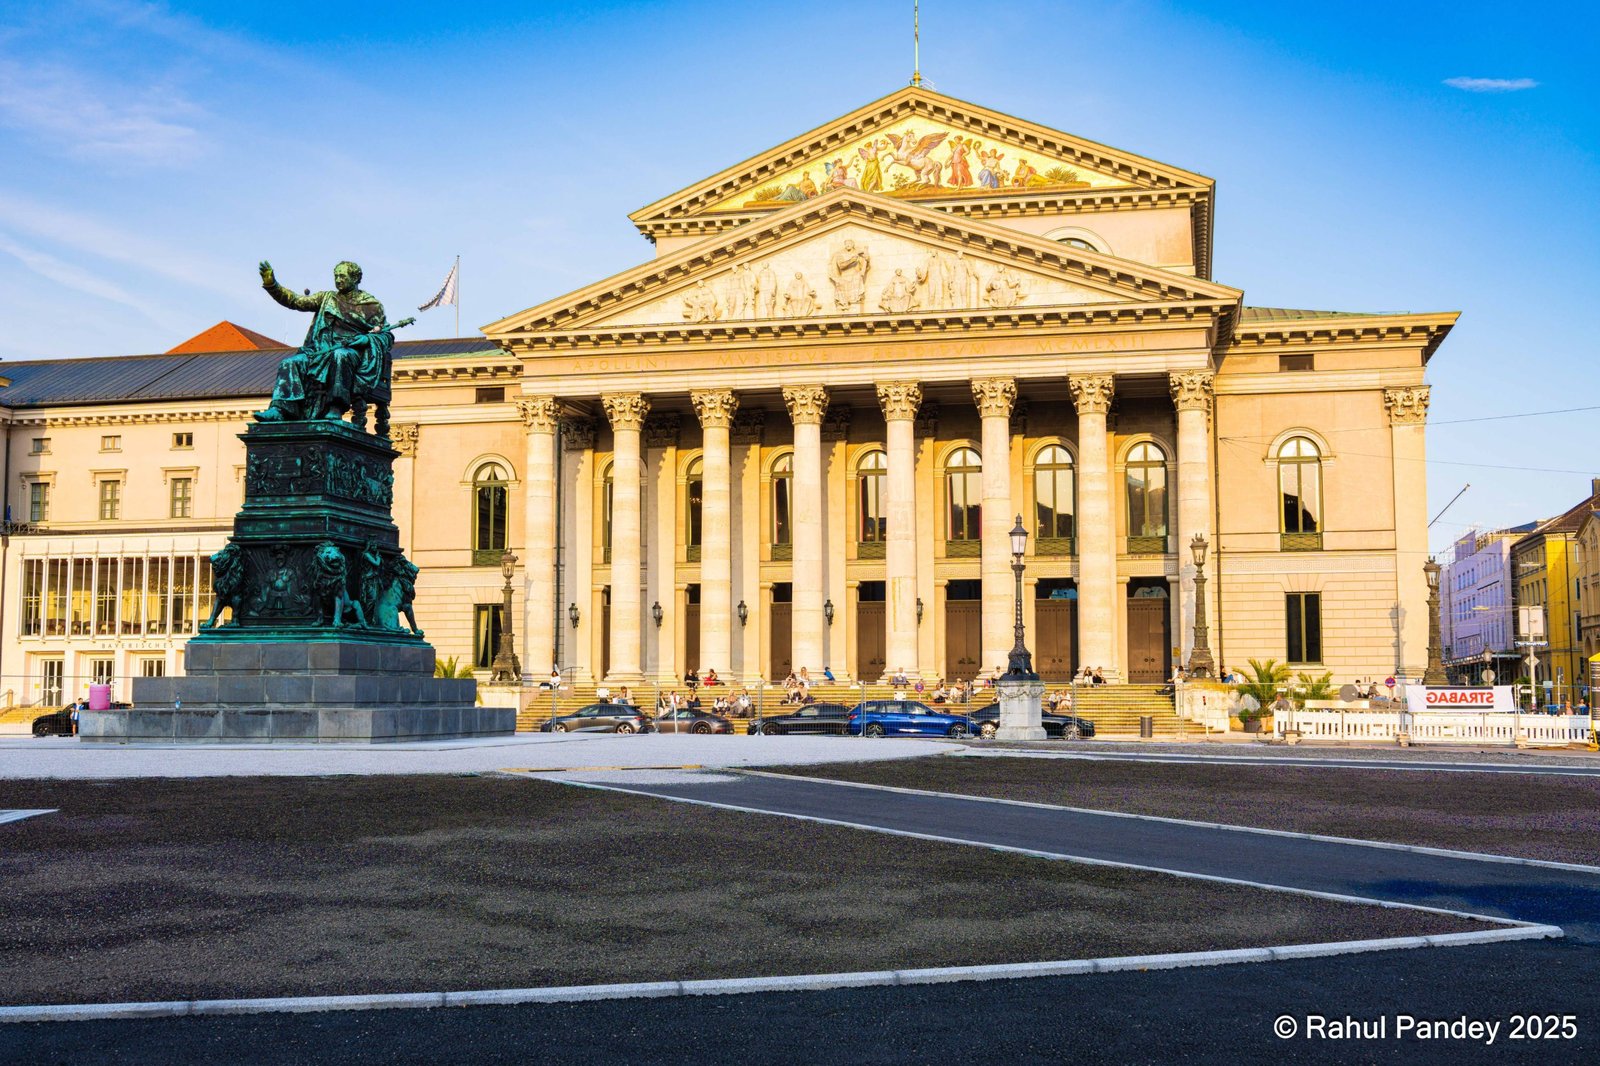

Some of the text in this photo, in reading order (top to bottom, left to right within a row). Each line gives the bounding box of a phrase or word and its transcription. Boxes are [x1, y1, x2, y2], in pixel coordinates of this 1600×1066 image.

[573, 358, 668, 371] APOLLINI
[718, 350, 829, 366] MVSISQVE
[1035, 336, 1144, 352] MCMLXIII
